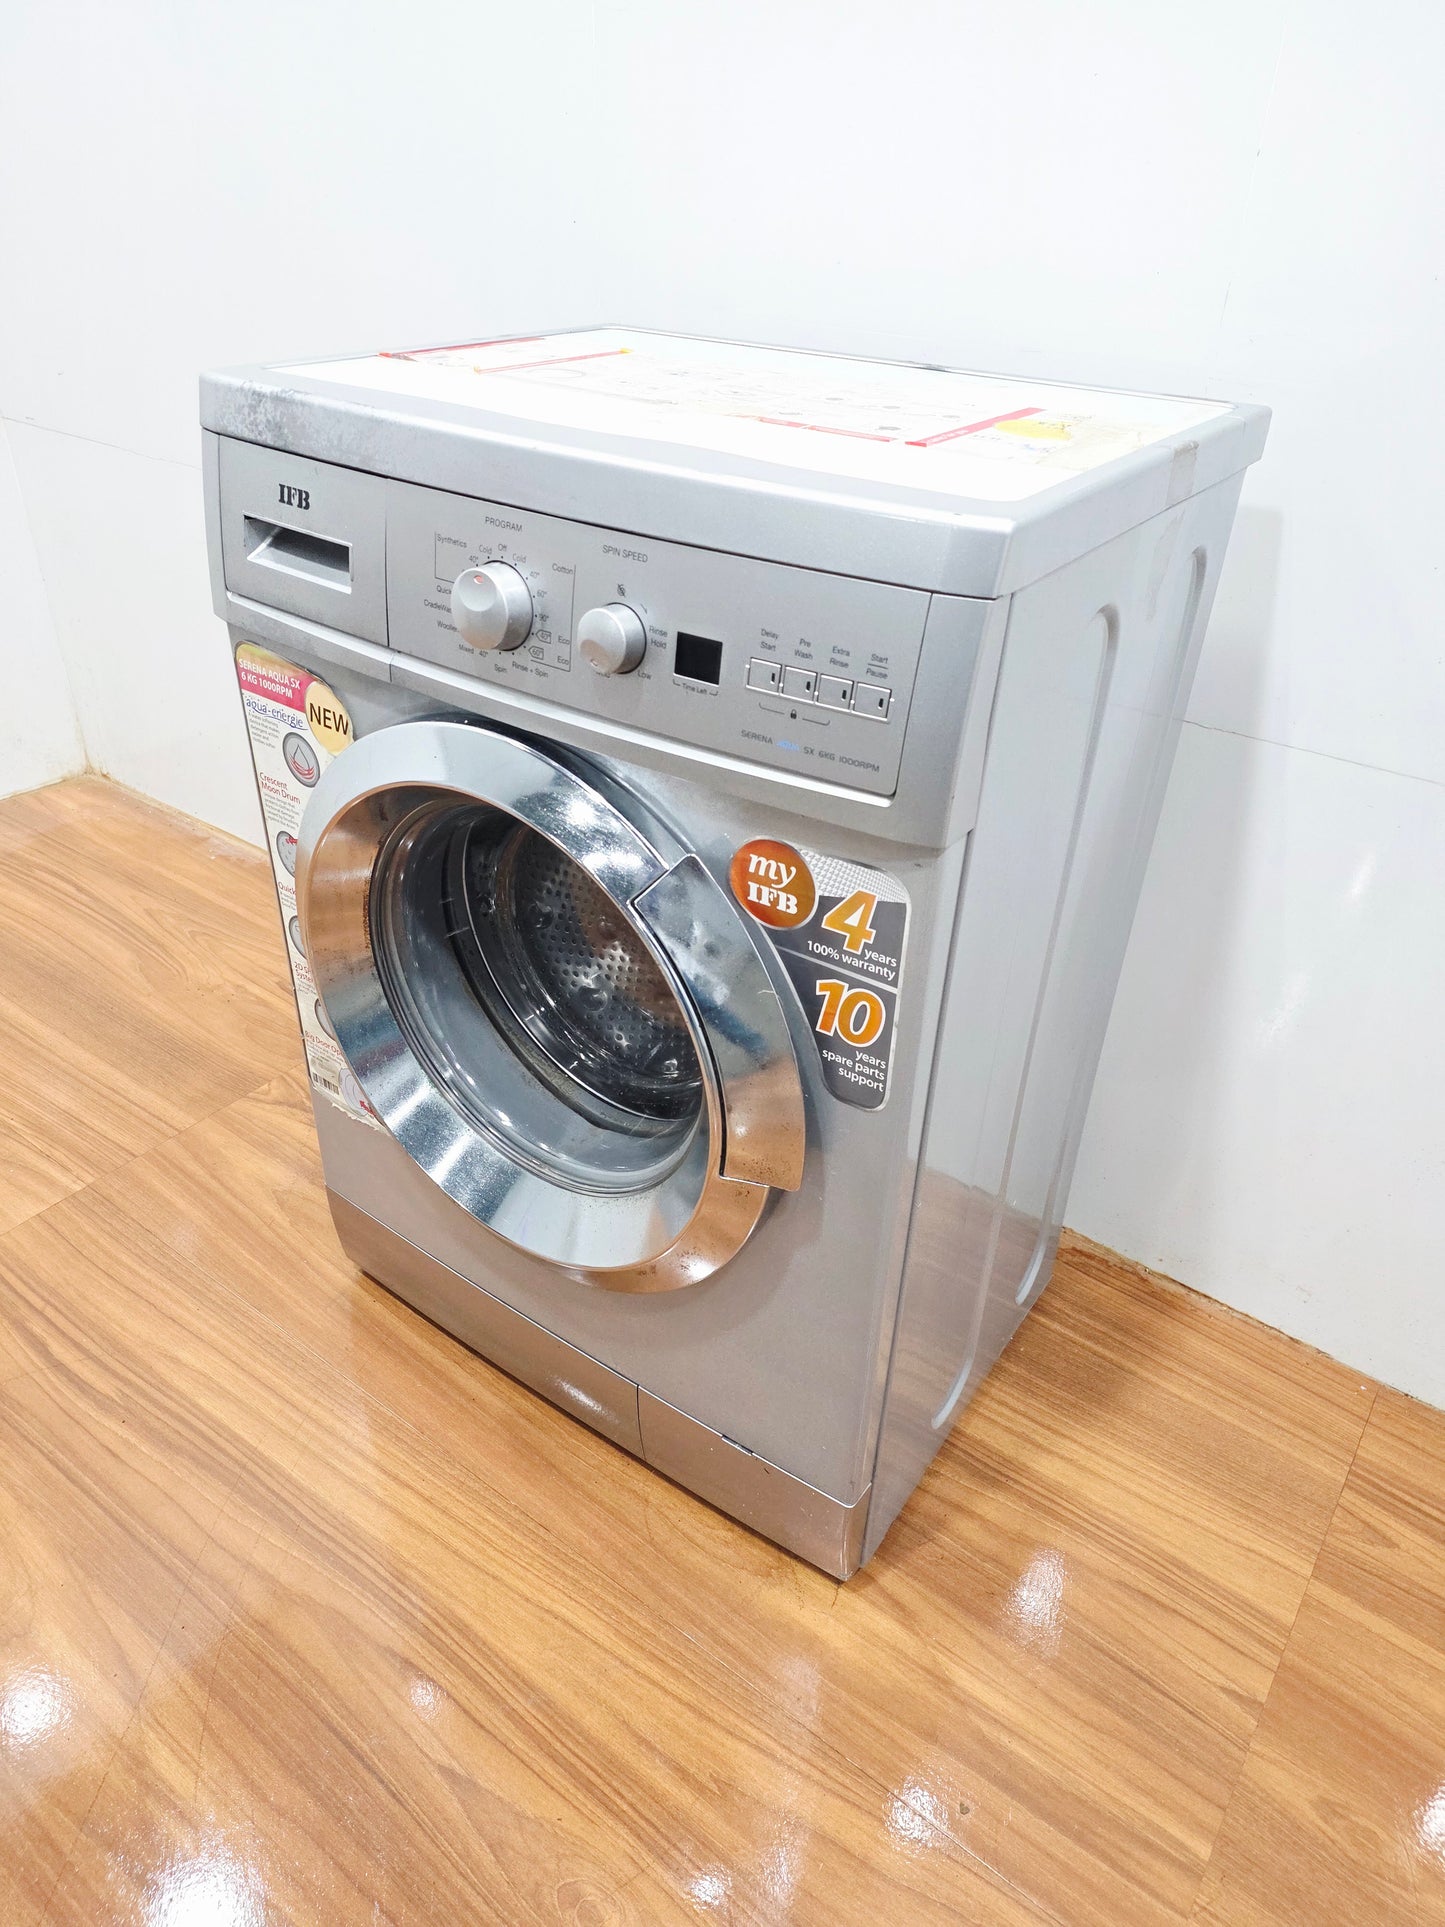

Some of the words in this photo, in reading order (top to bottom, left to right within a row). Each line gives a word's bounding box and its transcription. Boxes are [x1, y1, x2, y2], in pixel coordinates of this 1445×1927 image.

[279, 483, 310, 510] IFB
[485, 516, 523, 532] PROGRAM
[436, 534, 467, 549] Synthetics
[498, 543, 507, 552] Off
[479, 544, 492, 555] Cold
[602, 545, 621, 558] SPIN
[622, 549, 648, 563] SPEED
[512, 553, 526, 563] Cold
[552, 563, 574, 575] Cotton
[649, 625, 668, 637] Rinse
[761, 628, 780, 640] Delay
[558, 634, 570, 645] Eco
[650, 639, 667, 649] Hold
[760, 641, 777, 652] Start
[799, 638, 811, 648] Pre
[794, 648, 813, 660] Wash
[832, 646, 850, 657] Extra
[871, 653, 889, 664] Start
[557, 655, 569, 665] Eco
[829, 657, 849, 669] Rinse
[239, 658, 267, 677] SERENA
[268, 670, 290, 687] AQUA
[290, 678, 301, 690] SX
[494, 664, 507, 674] Spin
[512, 661, 529, 673] Rinse
[534, 668, 549, 678] Spin
[637, 671, 652, 680] Low
[866, 668, 888, 680] Pause
[241, 672, 246, 680] 6
[247, 673, 258, 685] KG
[259, 678, 293, 699] 1000RPM
[682, 682, 696, 692] Time
[696, 686, 708, 695] Left
[309, 703, 349, 735] NEW
[741, 729, 773, 744] SERENA
[803, 746, 815, 756] SX
[818, 750, 836, 761] 6KG
[839, 756, 880, 772] 1000RPM
[261, 781, 281, 796] Moon
[282, 789, 301, 804] Drum
[748, 853, 797, 889] my
[747, 881, 798, 915] IFB
[821, 889, 878, 955] 4
[864, 949, 897, 967] years
[807, 940, 840, 960] 100%
[841, 953, 896, 981] warranty
[816, 979, 886, 1048] 10
[822, 1049, 854, 1067] spare
[855, 1061, 885, 1080] parts
[856, 1050, 887, 1069] years
[838, 1067, 884, 1092] support
